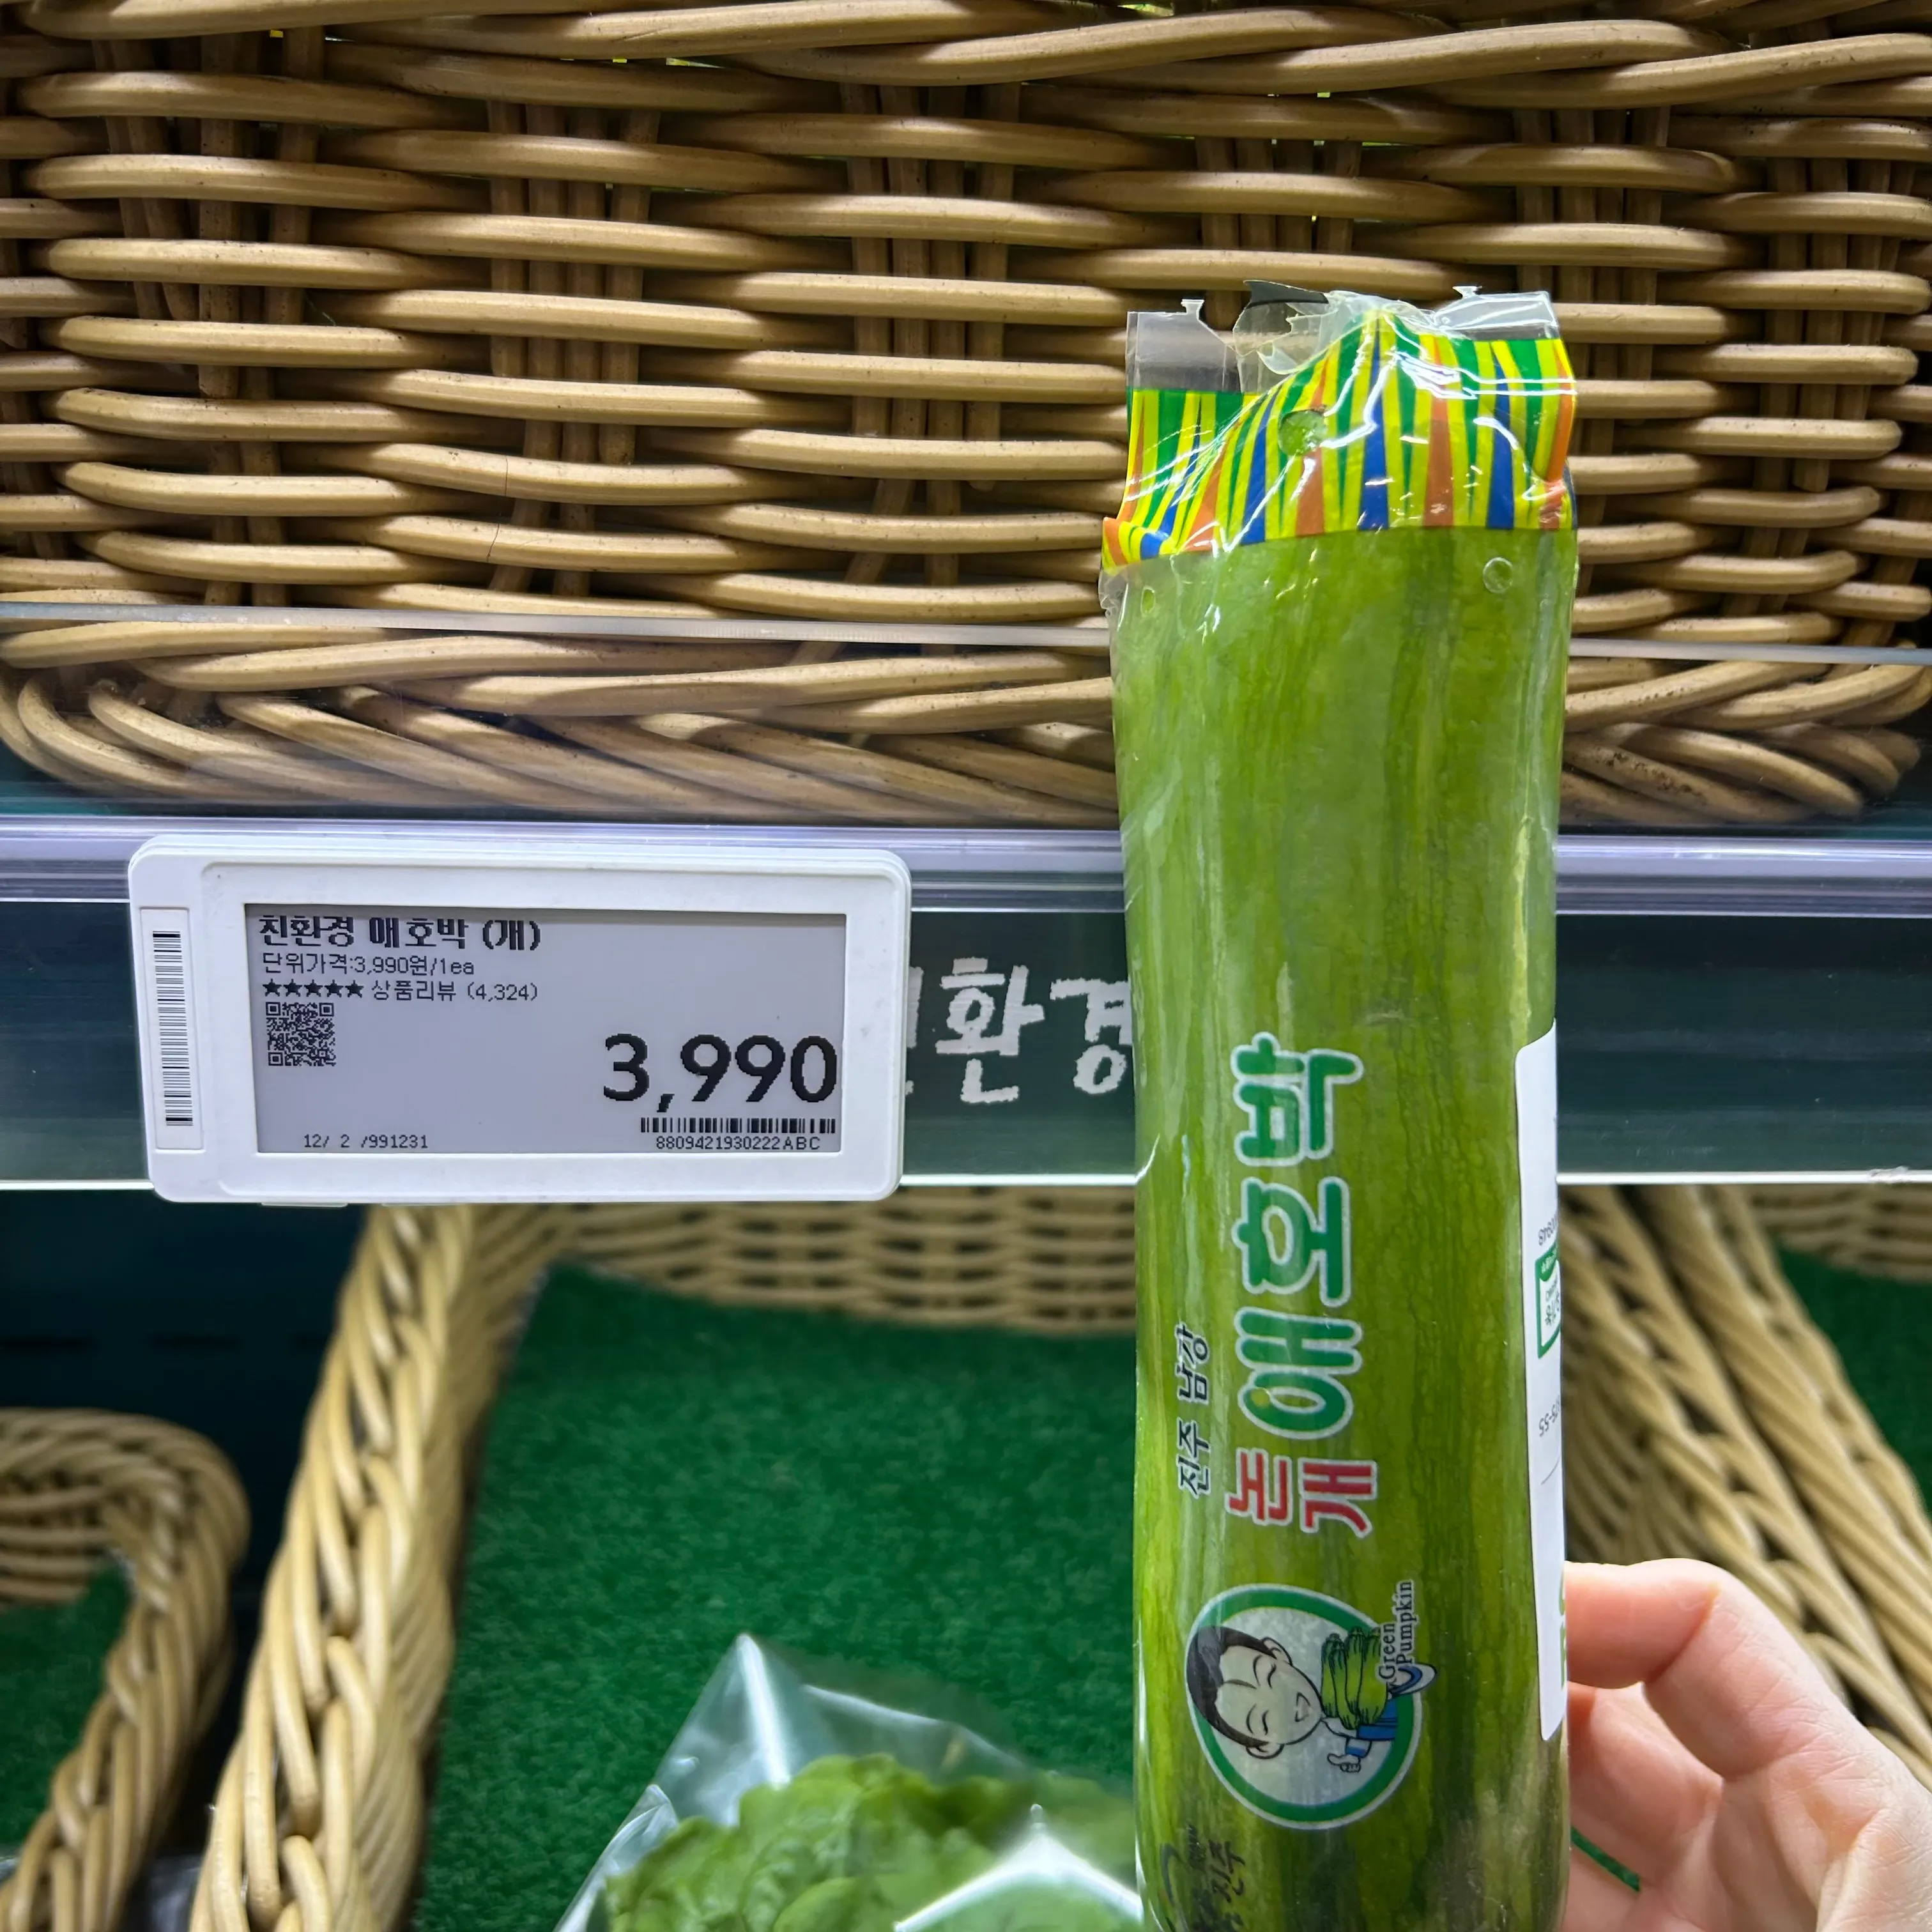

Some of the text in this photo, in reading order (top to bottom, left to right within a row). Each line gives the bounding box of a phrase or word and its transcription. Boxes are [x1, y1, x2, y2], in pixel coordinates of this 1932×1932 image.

[259, 915, 541, 951] 친환경 애호박 (개)
[263, 953, 475, 976] 단위가격:3,990원/1ea
[371, 980, 538, 1001] 상품리뷰 (4,324)
[905, 956, 1132, 1103] 환경
[603, 1033, 837, 1113] 3,990
[656, 1136, 820, 1150] 8809421930222ABC
[1225, 1031, 1377, 1537] 논개 애호박
[1176, 1323, 1210, 1498] 진주 남강
[1378, 1623, 1395, 1679] Green
[1395, 1581, 1417, 1664] Pumpkin
